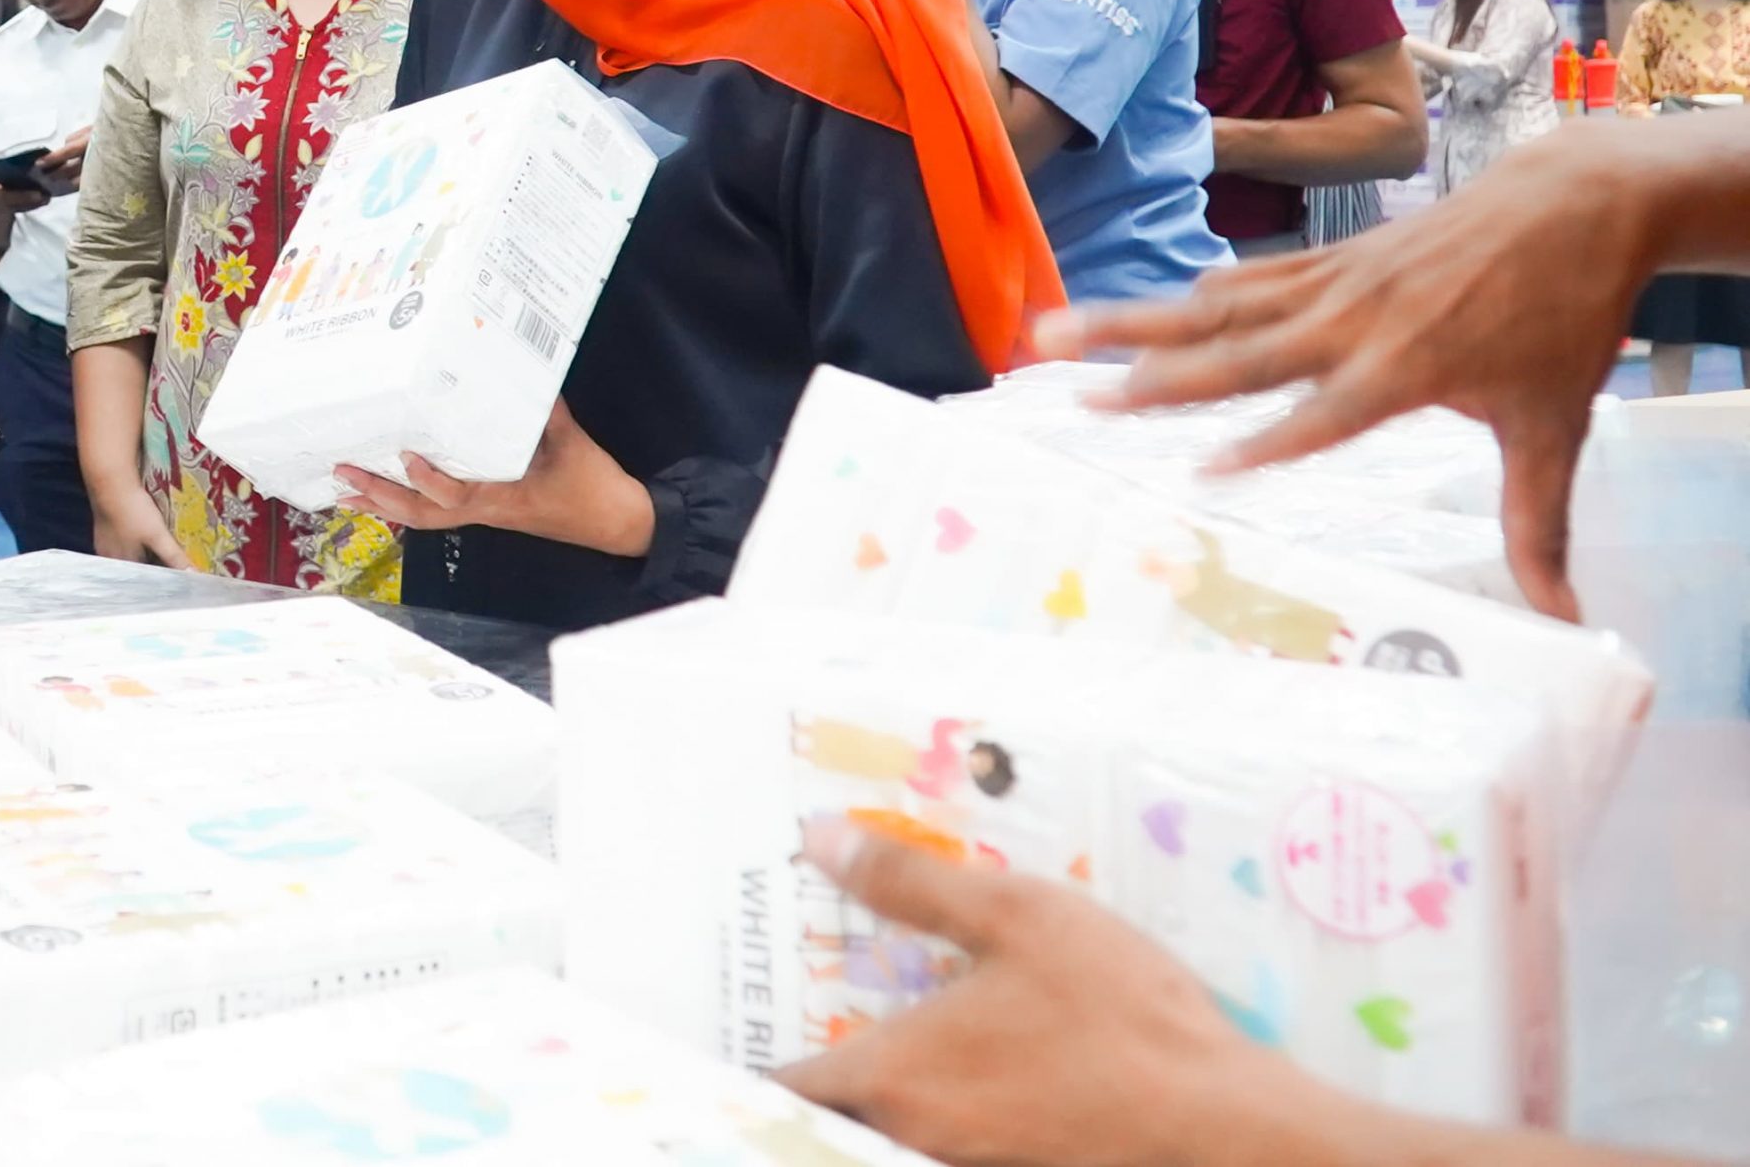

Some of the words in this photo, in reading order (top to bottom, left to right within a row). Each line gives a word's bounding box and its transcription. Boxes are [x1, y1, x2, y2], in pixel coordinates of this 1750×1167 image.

[284, 319, 325, 338] WHITE
[327, 307, 378, 329] RIBBON
[740, 867, 774, 1007] WHITE
